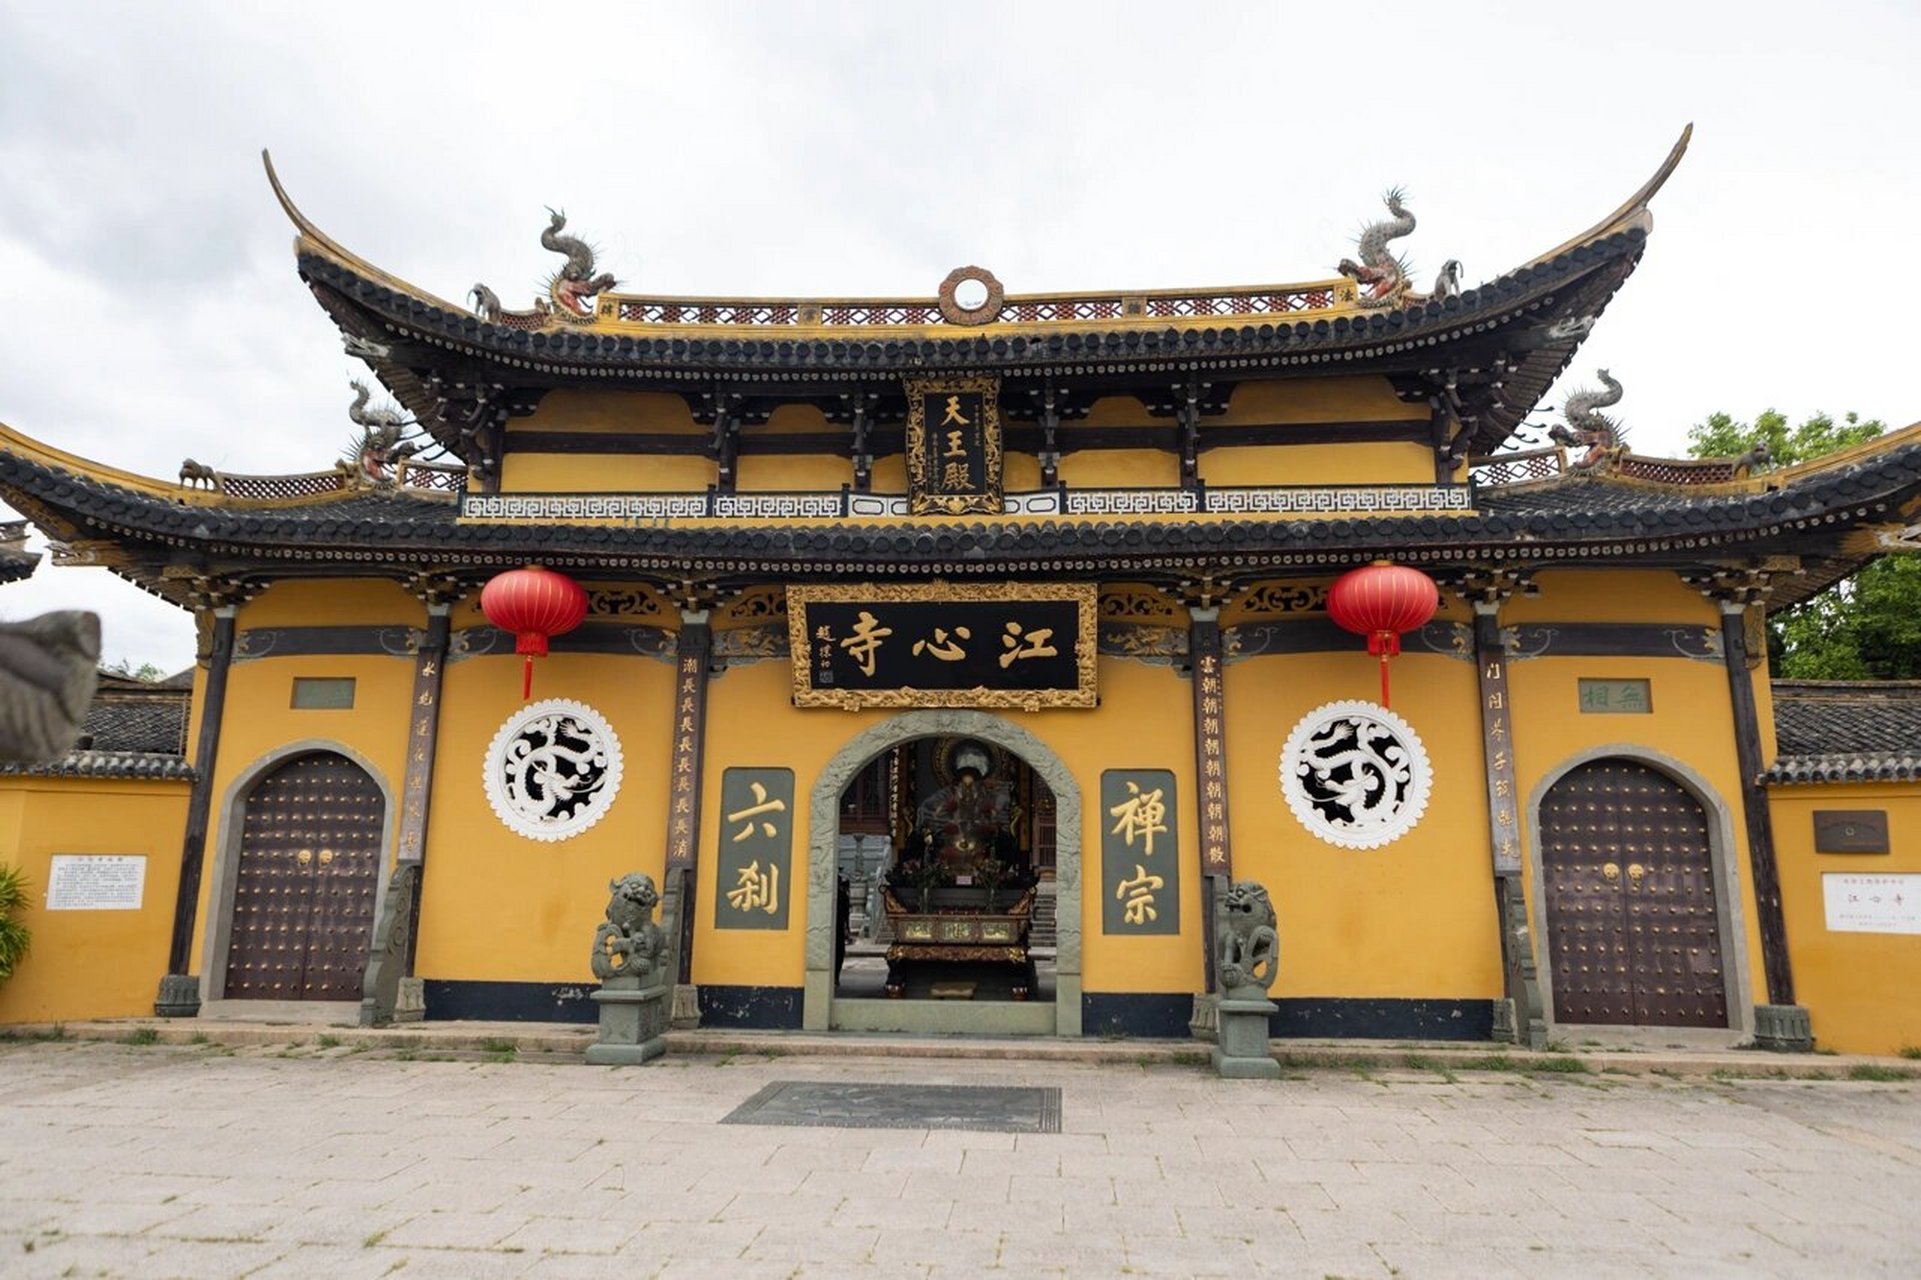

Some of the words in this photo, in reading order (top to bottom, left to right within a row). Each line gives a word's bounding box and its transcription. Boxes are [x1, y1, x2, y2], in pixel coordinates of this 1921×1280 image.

[940, 395, 977, 490] 天王殿
[840, 611, 1058, 677] 江心寺
[1200, 656, 1225, 864] 雲朝朝朝朝朝朝朝朝散
